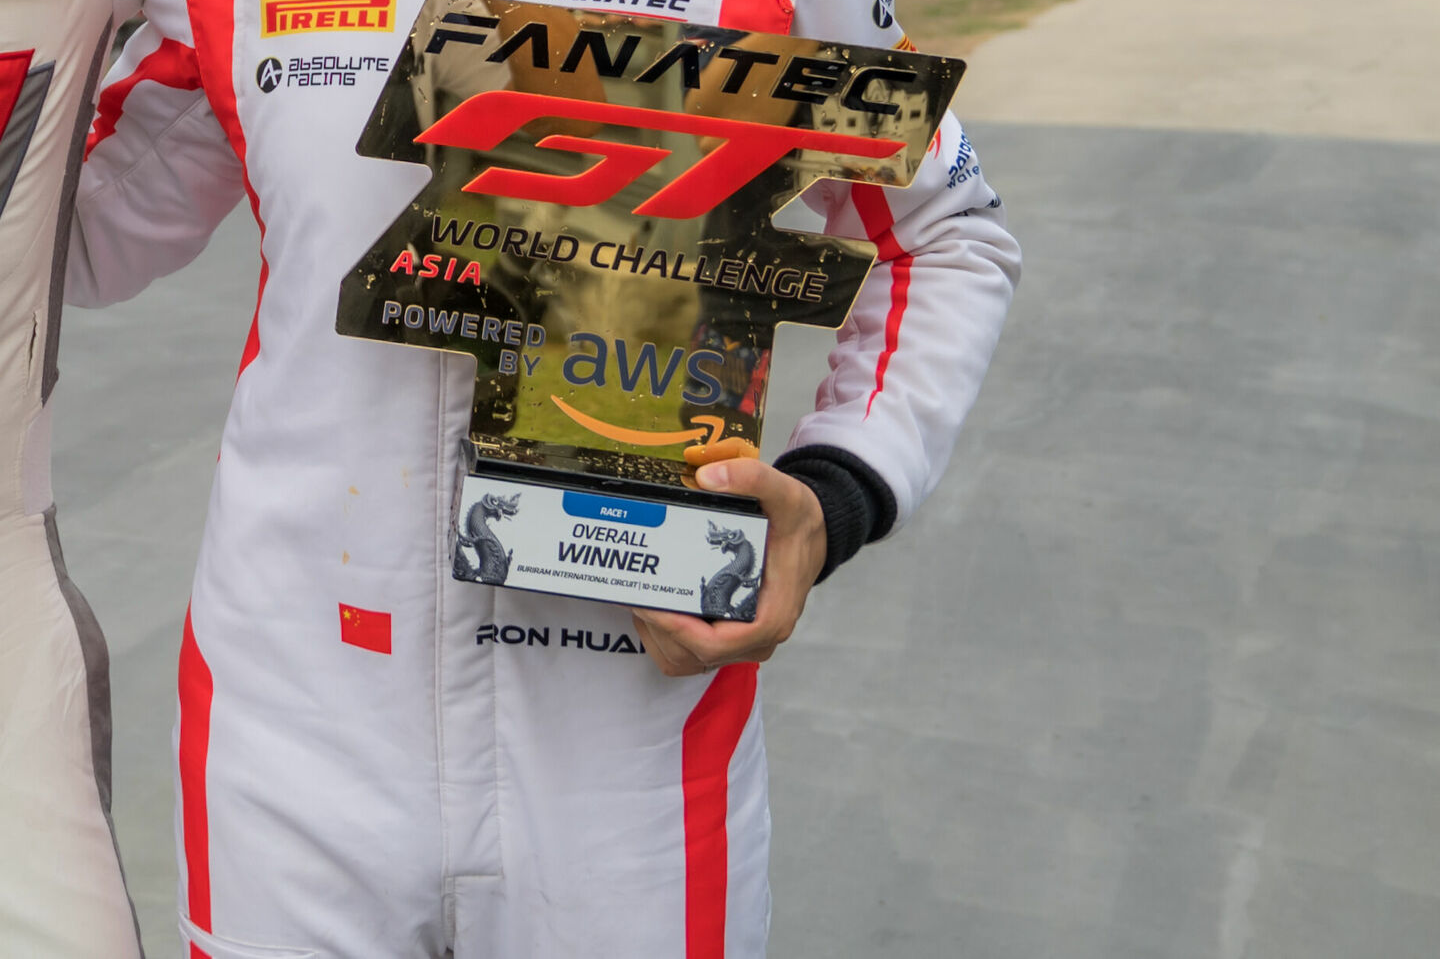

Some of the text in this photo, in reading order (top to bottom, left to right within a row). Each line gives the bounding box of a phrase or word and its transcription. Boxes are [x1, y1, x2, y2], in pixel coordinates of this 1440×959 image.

[425, 12, 917, 115] FANATEC
[413, 90, 908, 219] GT
[947, 165, 980, 189] wate
[391, 250, 481, 286] ASIA
[432, 216, 830, 304] WORLD CHALLENGE
[382, 301, 725, 406] POWERED aws
[498, 350, 541, 378] BY
[600, 506, 622, 518] RACE
[572, 523, 648, 548] OVERALL
[558, 541, 660, 575] WINNER
[517, 564, 551, 576] BURIRAM
[552, 569, 609, 584] INTERNATIONAL
[610, 578, 639, 589] CIRCUIT
[660, 585, 676, 594] MAY
[676, 587, 693, 596] 2024
[476, 624, 646, 654] RON HUA
